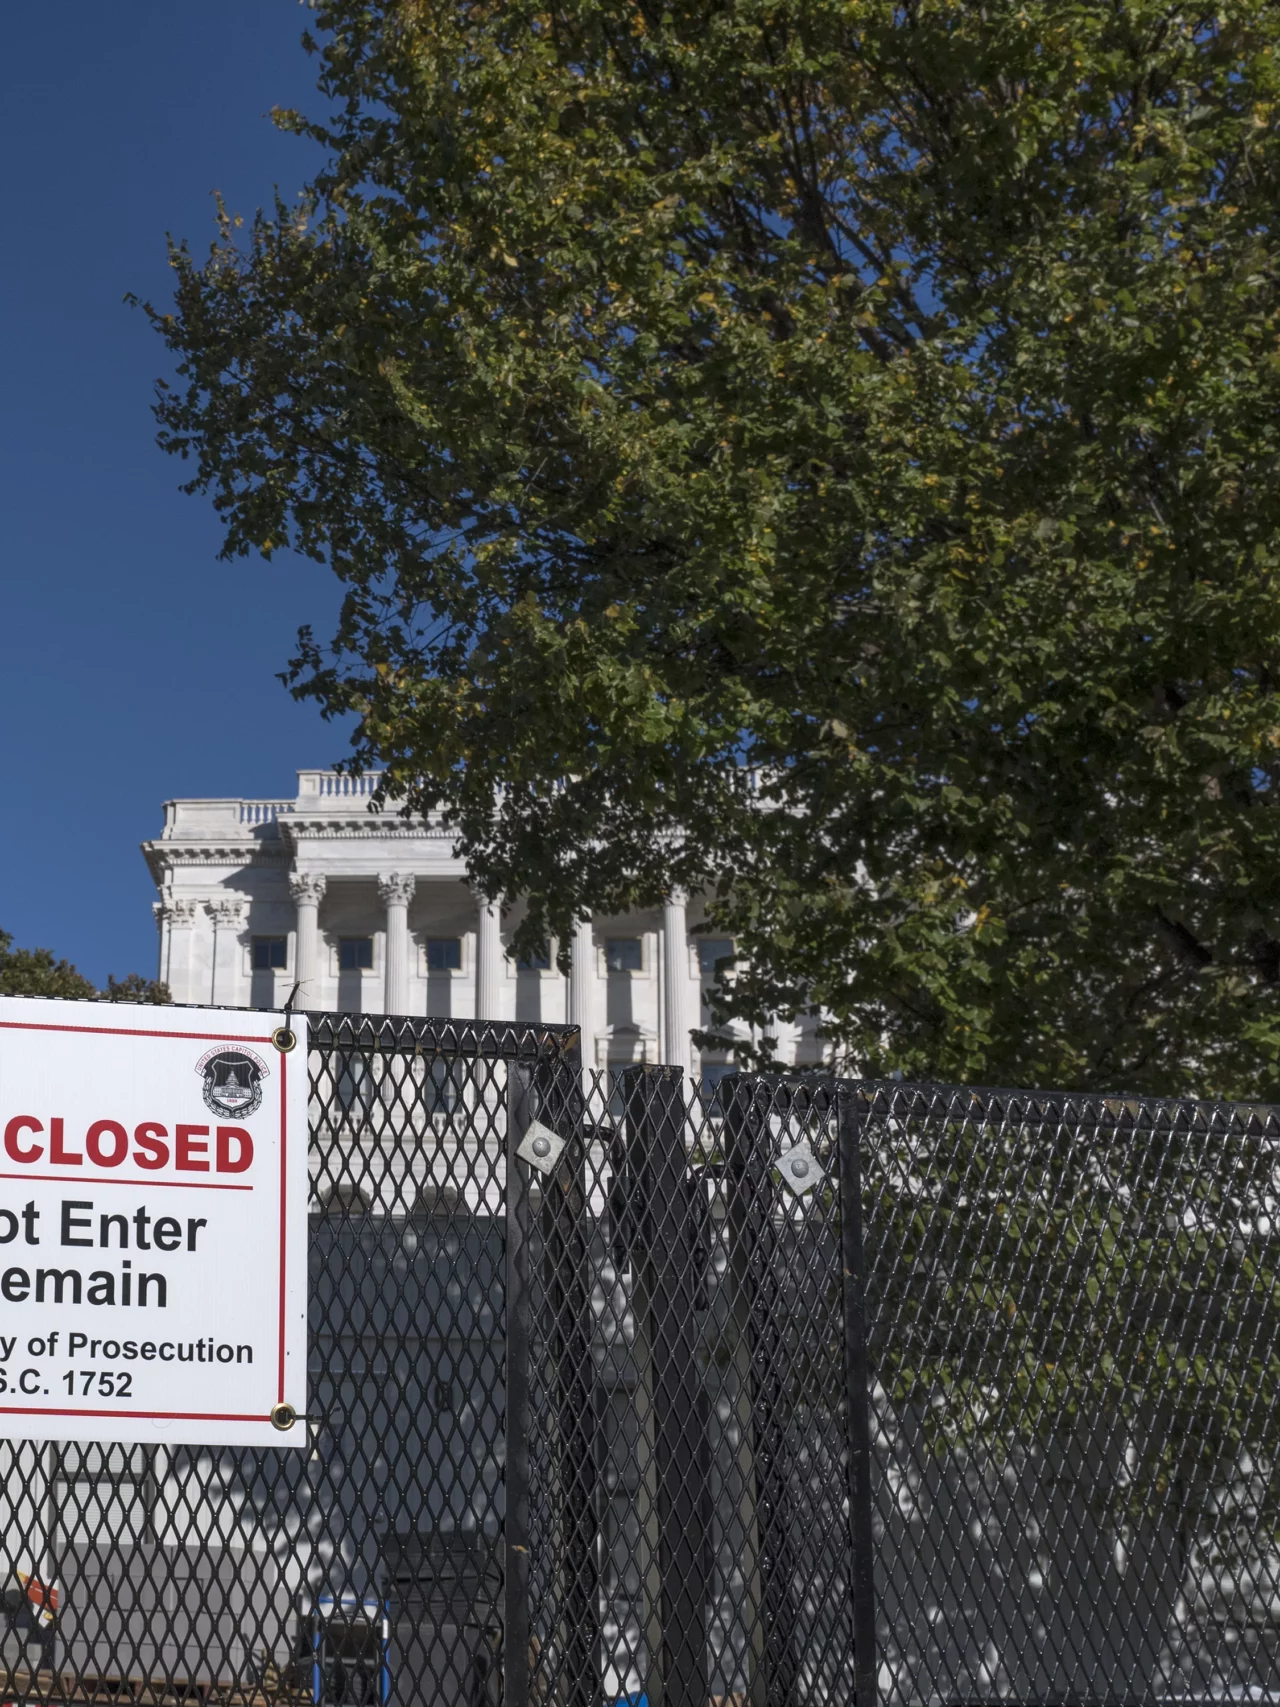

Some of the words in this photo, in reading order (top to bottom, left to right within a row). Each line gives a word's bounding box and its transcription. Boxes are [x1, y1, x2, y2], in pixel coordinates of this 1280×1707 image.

[196, 1053, 212, 1071] UNITED
[210, 1046, 230, 1056] STATES
[231, 1046, 253, 1058] CAPITOL
[253, 1056, 268, 1074] POLICE
[3, 1115, 254, 1174] CLOSED
[60, 1200, 208, 1252] Enter
[27, 1331, 60, 1357] of
[68, 1332, 254, 1364] Prosecution
[62, 1370, 133, 1398] 1752
